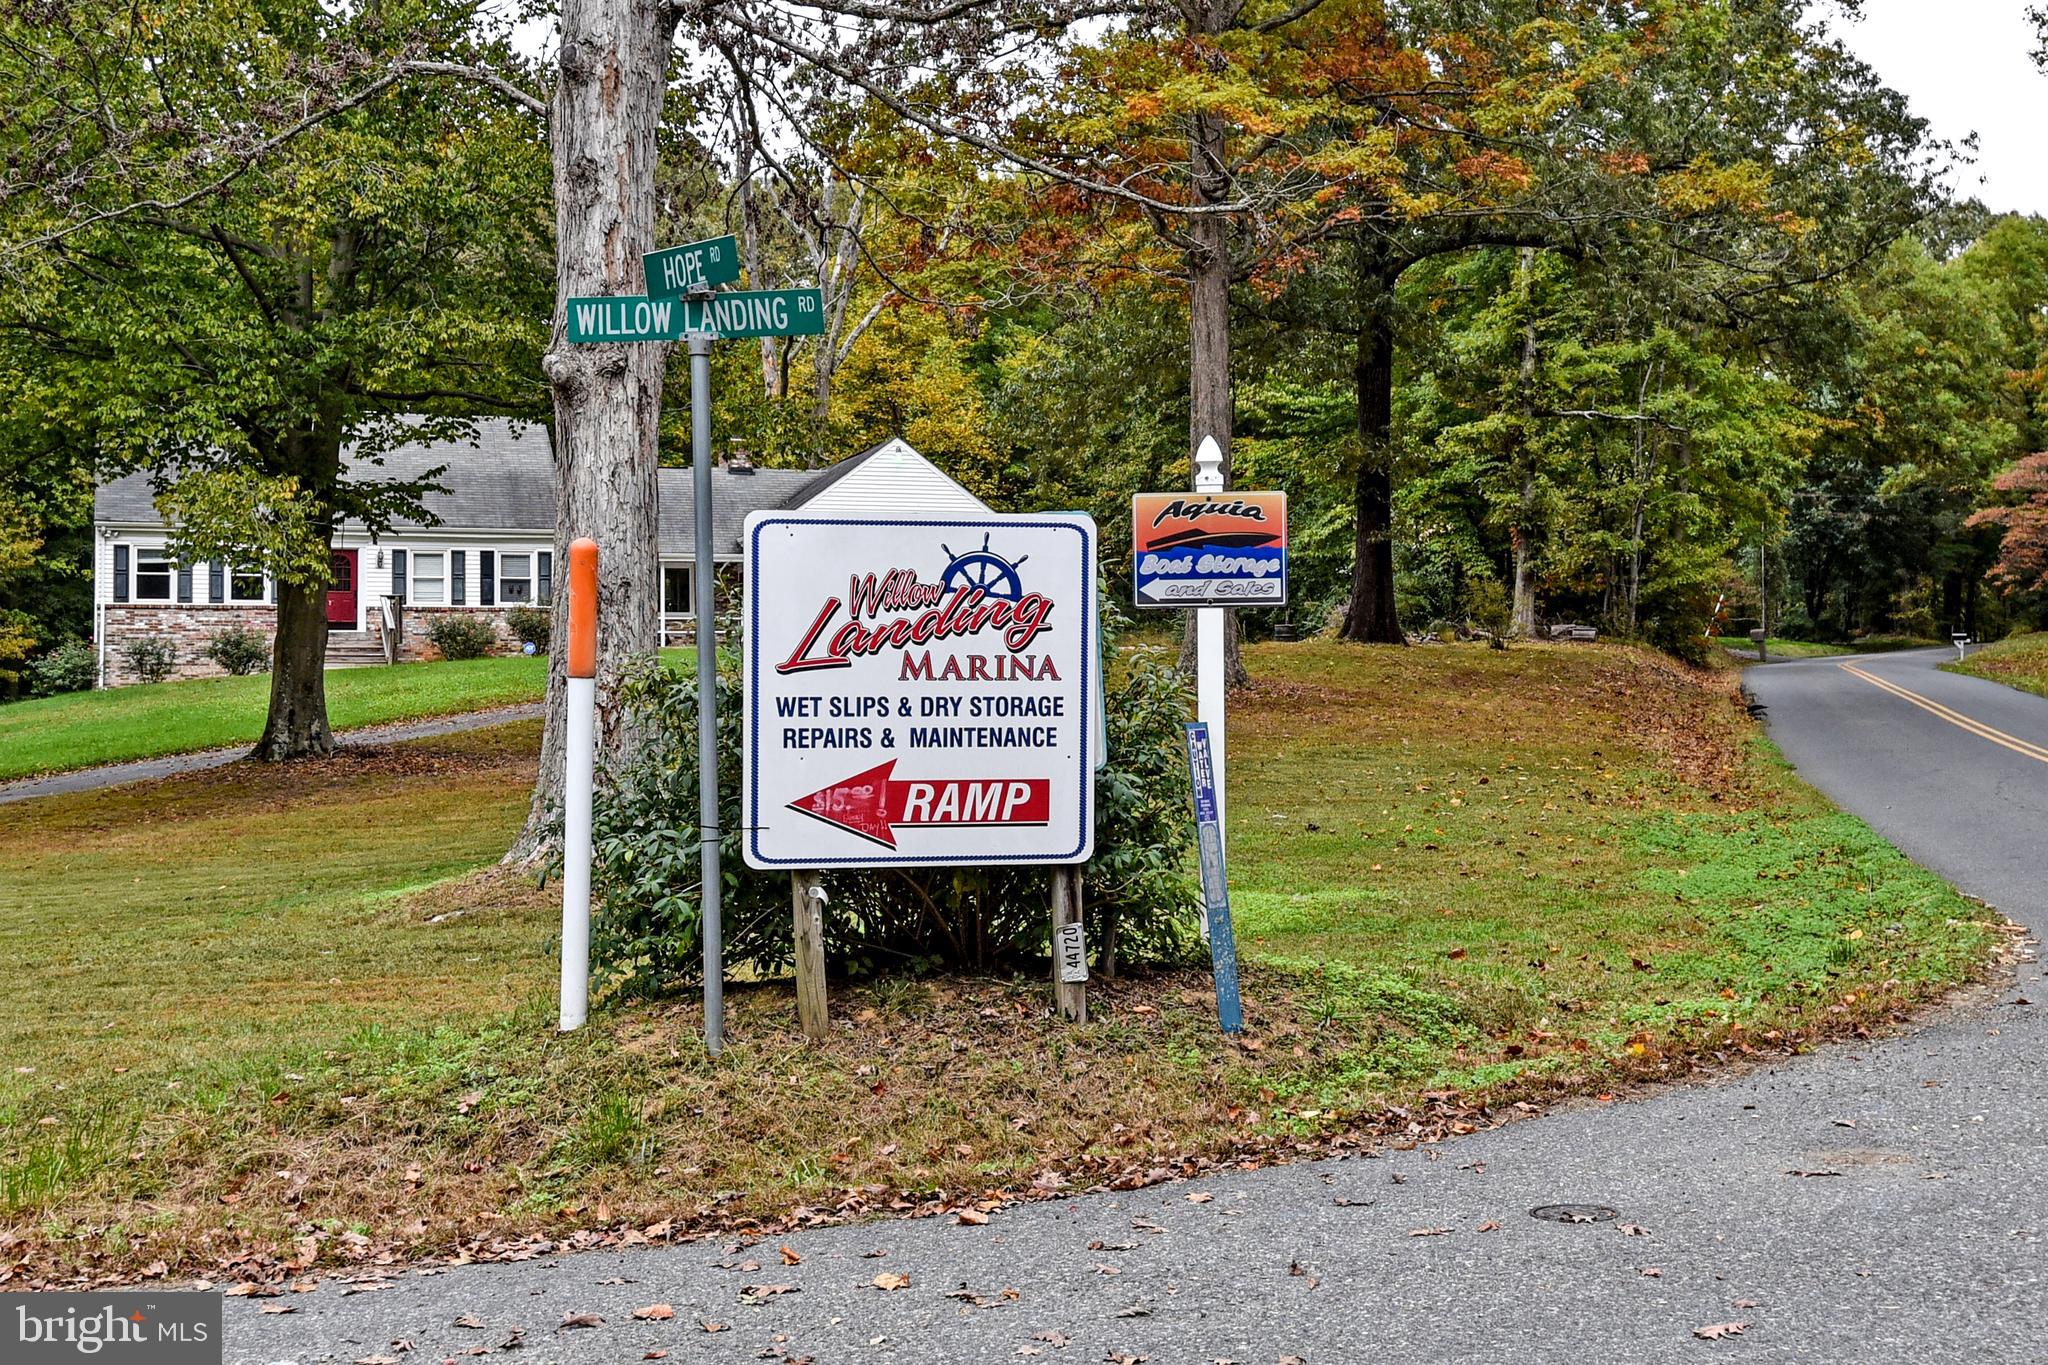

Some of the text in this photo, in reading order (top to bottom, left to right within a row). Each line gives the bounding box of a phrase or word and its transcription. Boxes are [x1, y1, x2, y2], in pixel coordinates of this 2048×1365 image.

[662, 246, 721, 290] HOPE RD
[576, 296, 815, 335] WILLOW LANDING RD
[1153, 501, 1266, 527] Aquia
[1140, 554, 1280, 577] Boat Storage
[850, 568, 945, 617] Willow
[1165, 580, 1275, 597] and Sales
[775, 586, 1054, 674] Landing
[898, 650, 1062, 681] MARINA
[776, 697, 1064, 717] WET SLIPS & DRY STORAGE
[783, 728, 1057, 748] REPAIRS & MAINTENANCE
[902, 783, 1031, 822] RAMP
[1063, 928, 1081, 968] 44720
